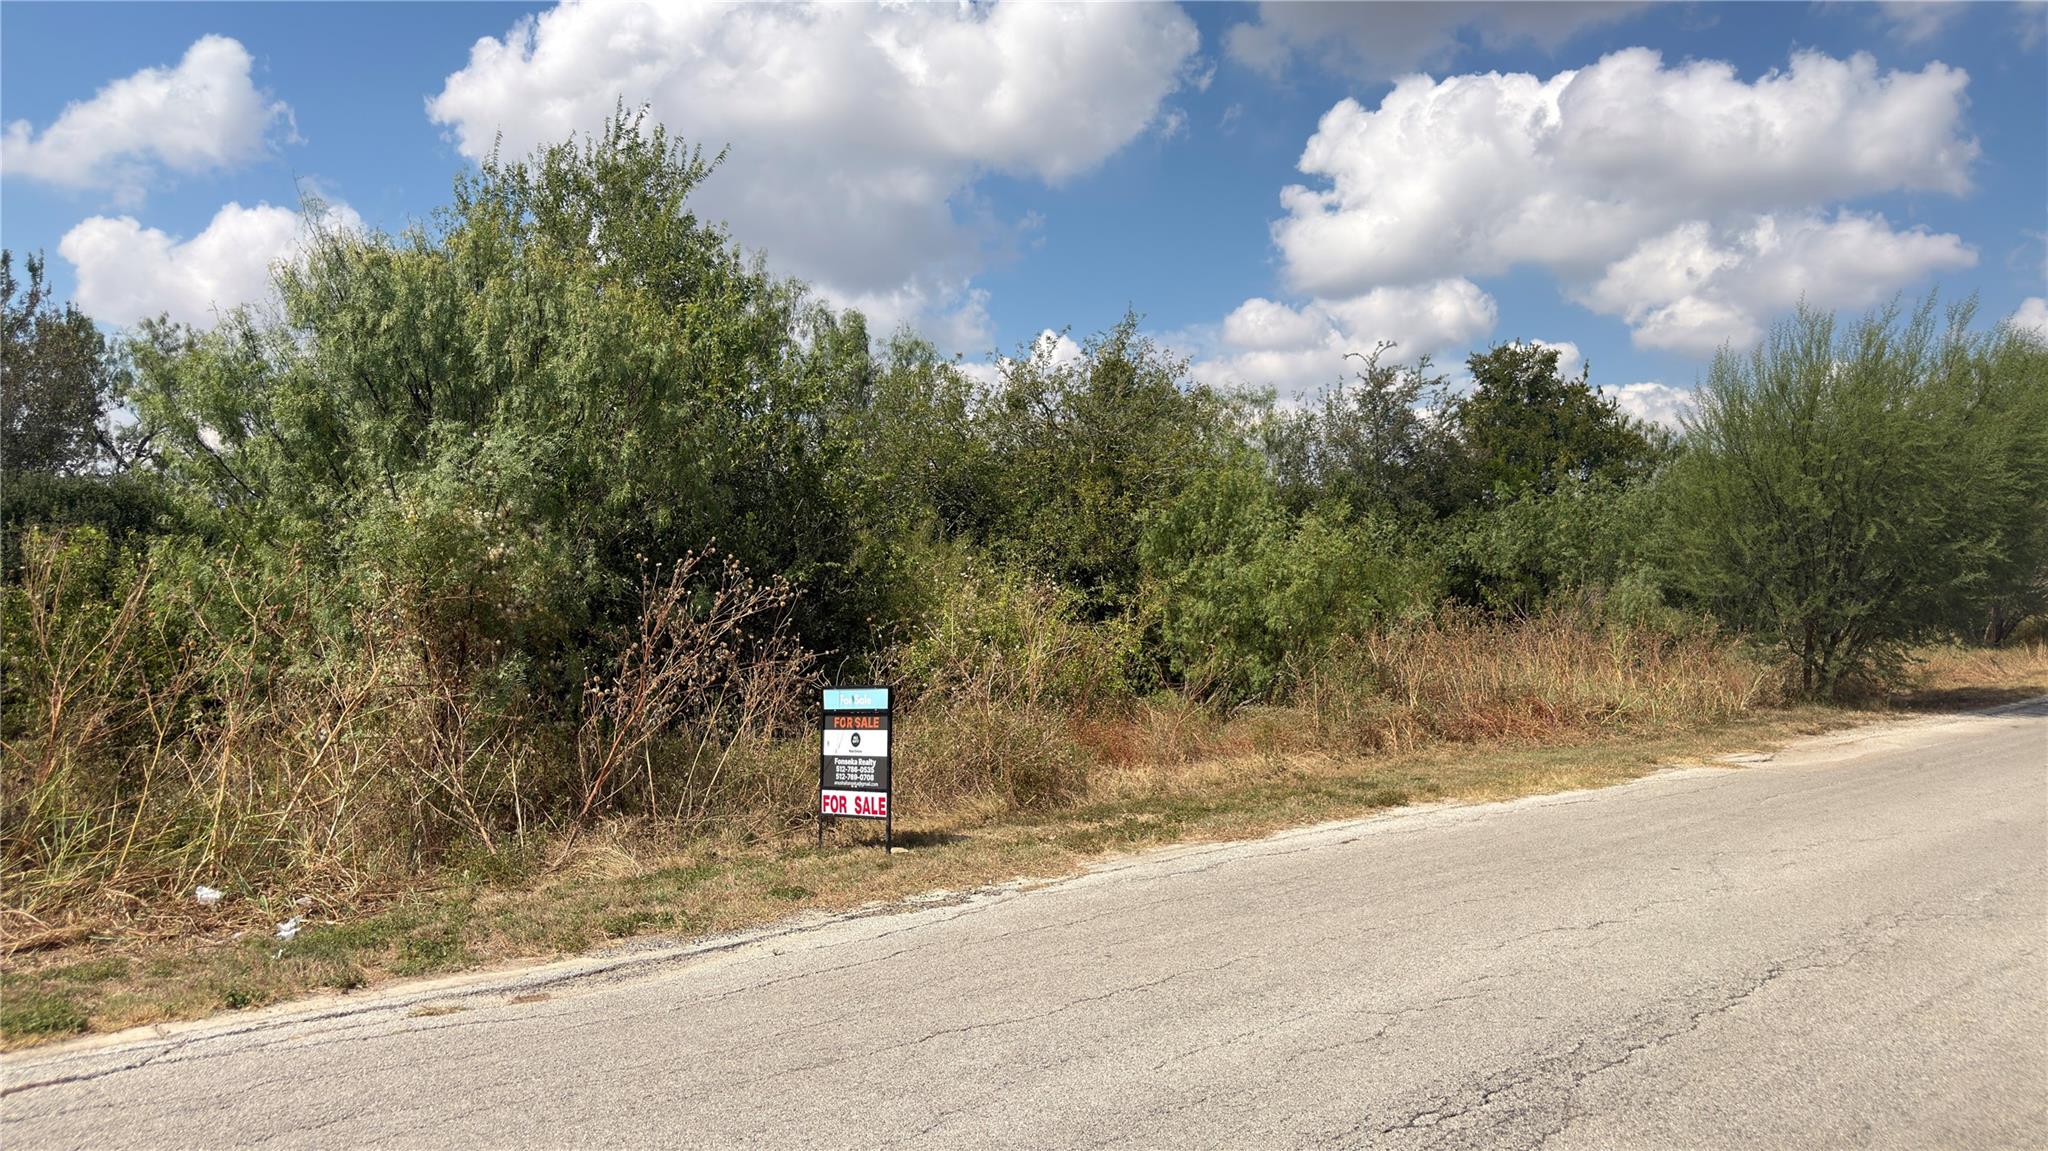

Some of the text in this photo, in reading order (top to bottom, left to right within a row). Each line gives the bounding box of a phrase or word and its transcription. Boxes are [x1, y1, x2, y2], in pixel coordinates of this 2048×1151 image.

[833, 717, 880, 728] FOR SALE
[858, 758, 876, 768] Realty
[823, 795, 886, 815] FOR SALE
